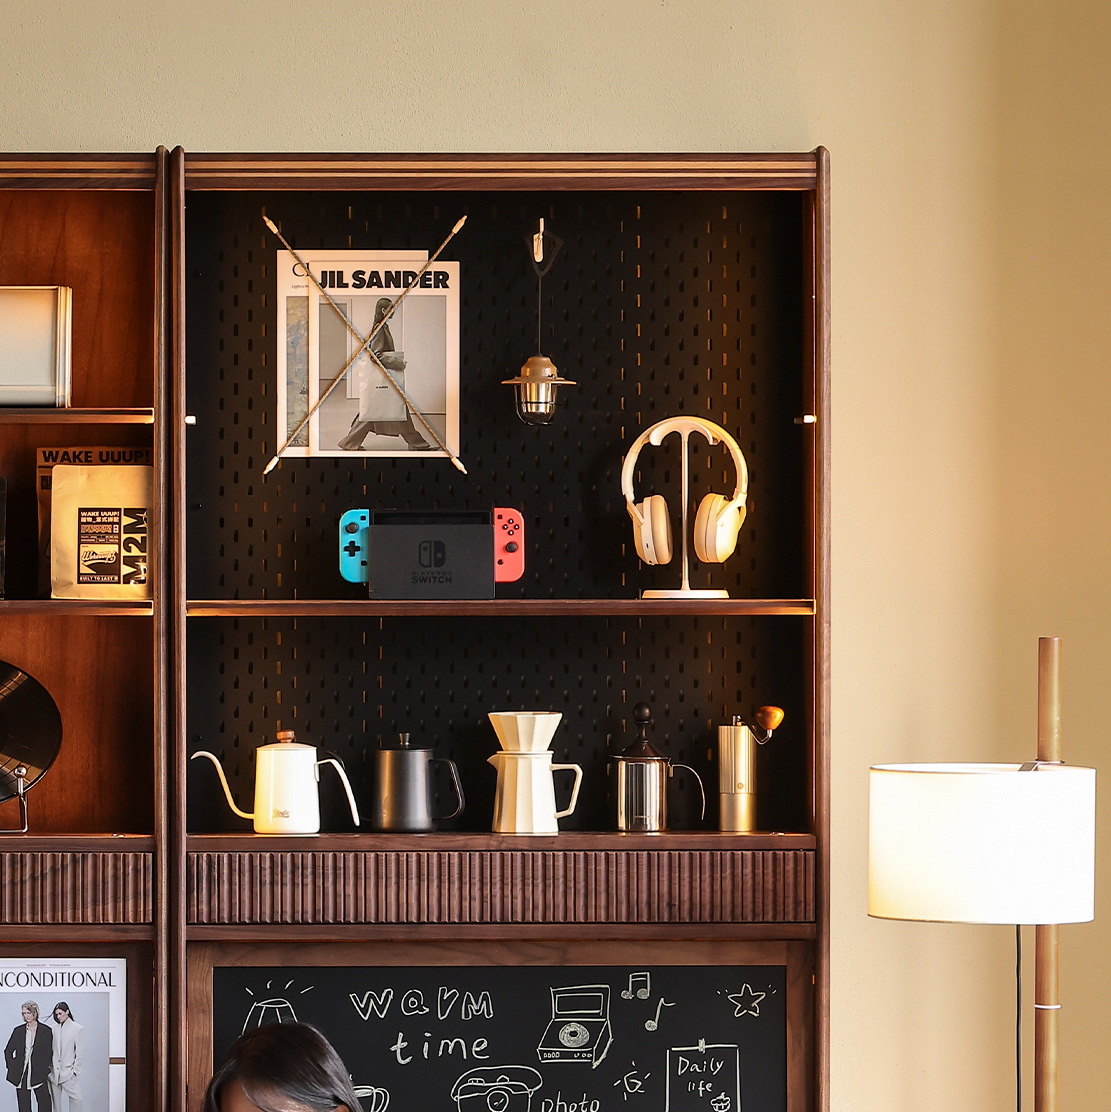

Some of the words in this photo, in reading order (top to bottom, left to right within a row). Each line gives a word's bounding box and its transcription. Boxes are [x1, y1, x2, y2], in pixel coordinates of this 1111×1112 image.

[319, 270, 349, 289] JIL
[351, 269, 450, 289] SANDER
[42, 450, 93, 463] WAKE
[98, 450, 150, 463] UUUP!
[412, 576, 453, 584] SWITCH
[390, 1031, 490, 1064] time
[677, 1056, 724, 1076] Daily
[687, 1078, 714, 1093] life
